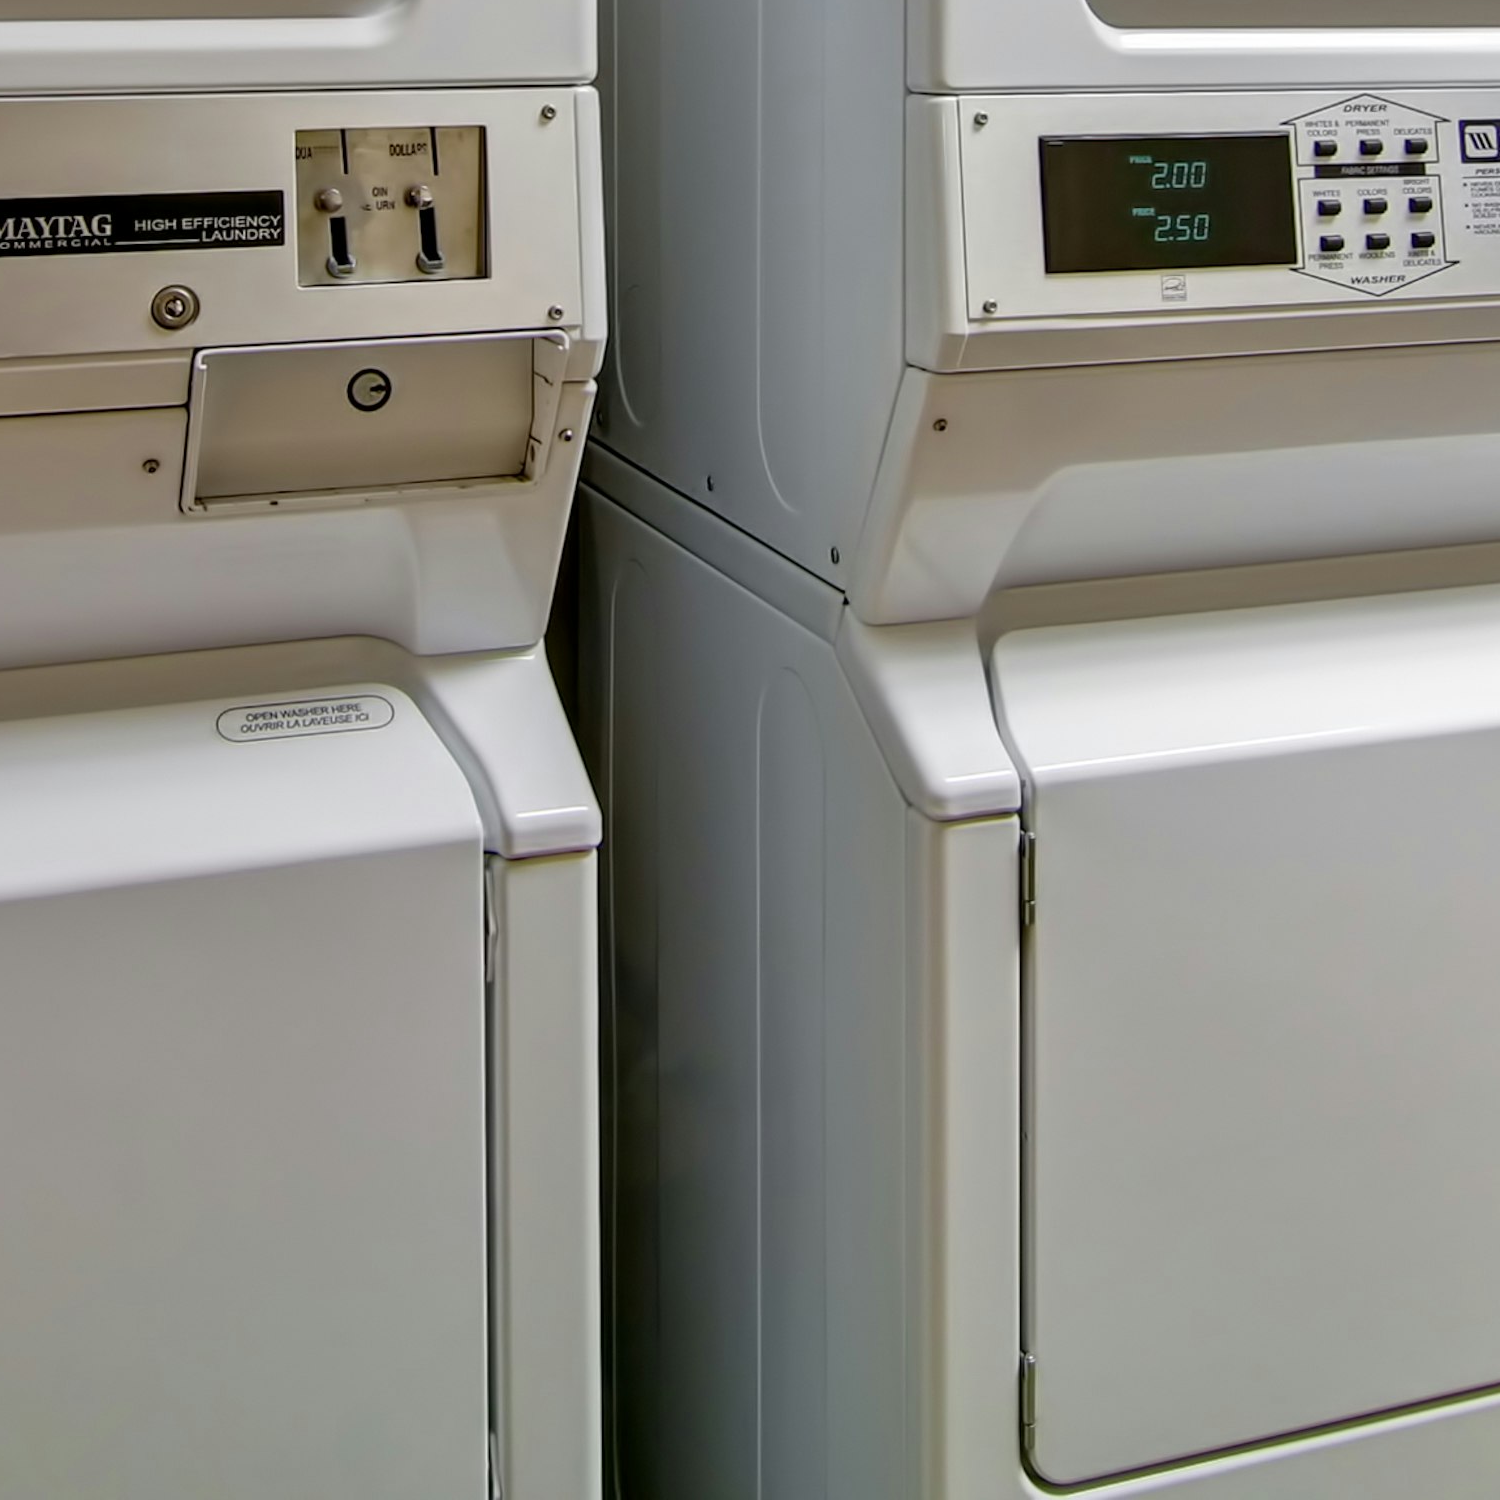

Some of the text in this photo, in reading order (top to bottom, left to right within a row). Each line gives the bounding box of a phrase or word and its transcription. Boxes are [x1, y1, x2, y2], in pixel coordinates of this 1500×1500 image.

[1344, 104, 1387, 113] DRYER
[1151, 162, 1206, 189] 2.00
[135, 215, 281, 232] HIGH EFFICIENCY
[1154, 214, 1209, 241] 2.50
[202, 228, 281, 242] LAUNDRY
[1308, 253, 1353, 261] PERMANENT
[1403, 258, 1441, 266] DELICATES
[1351, 275, 1405, 284] WASHER
[246, 703, 362, 722] OPEN WASHER HERE
[241, 713, 369, 734] OUVRIR LA LAVEUSE ICI
